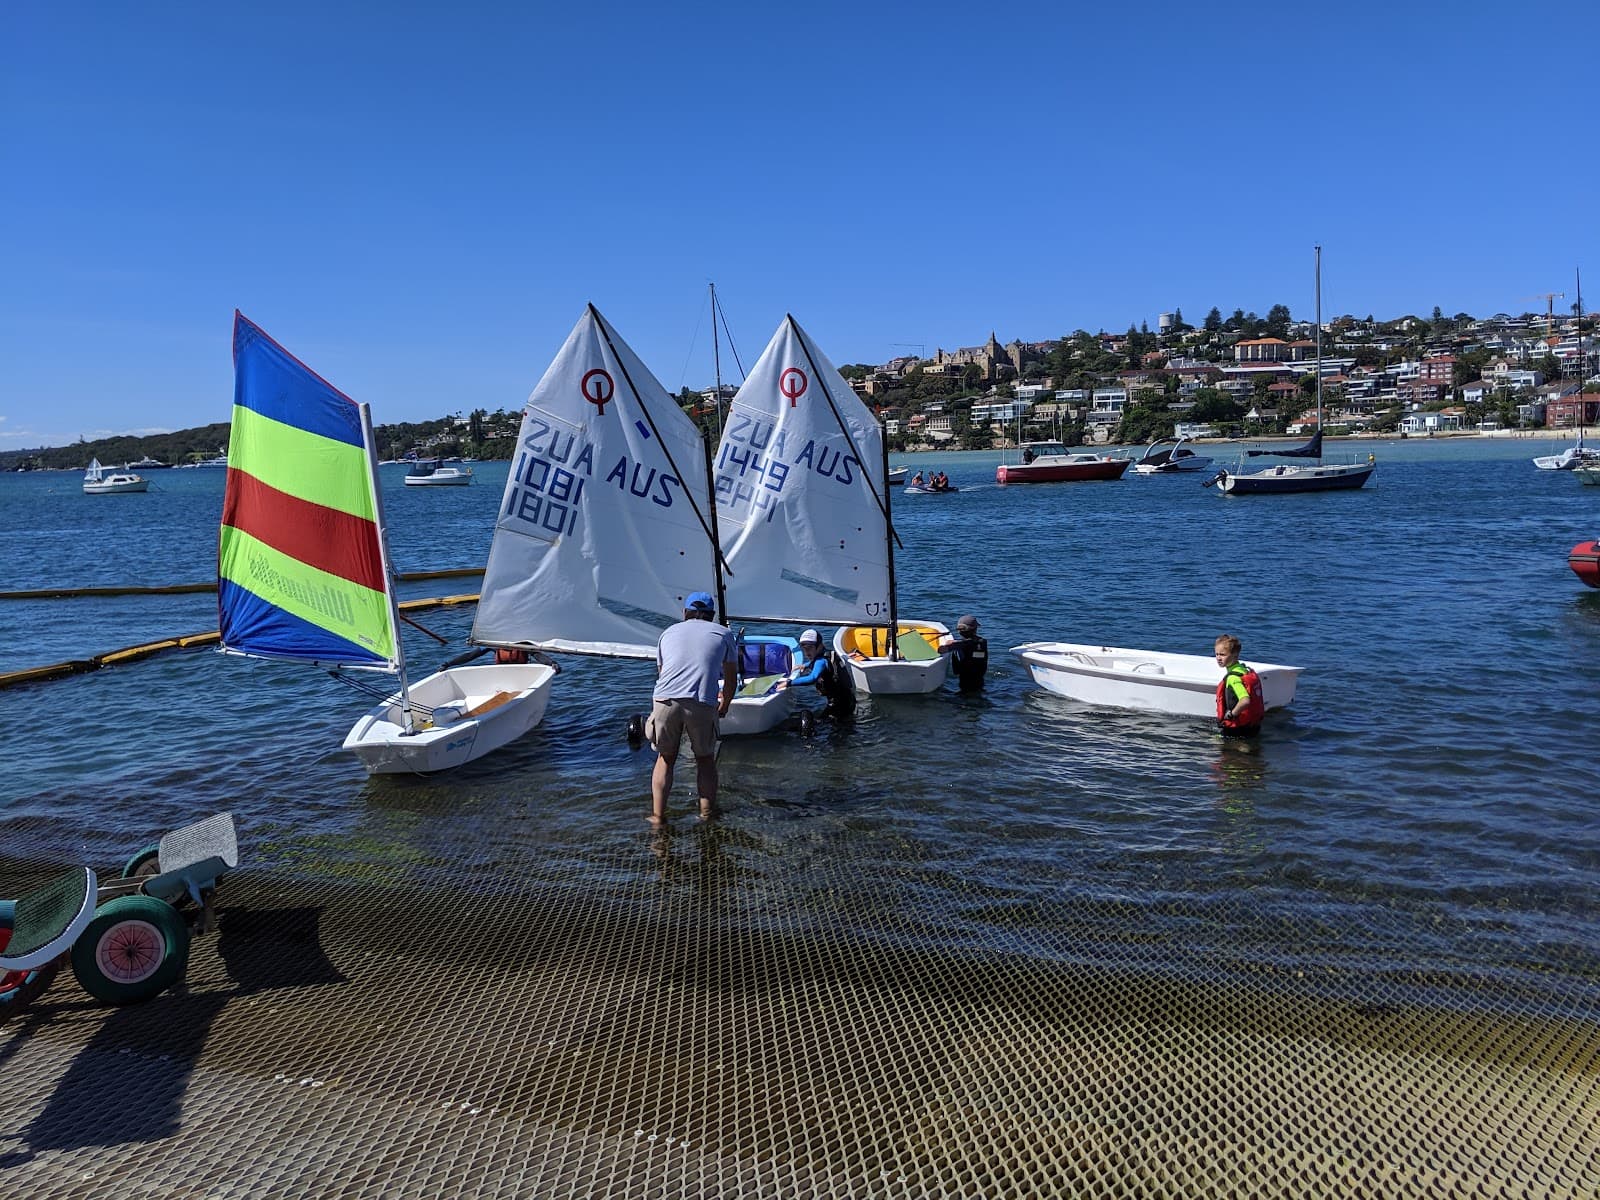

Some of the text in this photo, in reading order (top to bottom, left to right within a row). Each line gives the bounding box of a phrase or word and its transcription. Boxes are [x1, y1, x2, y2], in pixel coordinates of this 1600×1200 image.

[515, 452, 585, 506] 1081
[606, 456, 680, 508] AUS
[718, 442, 790, 493] 1449
[795, 440, 860, 485] AUS
